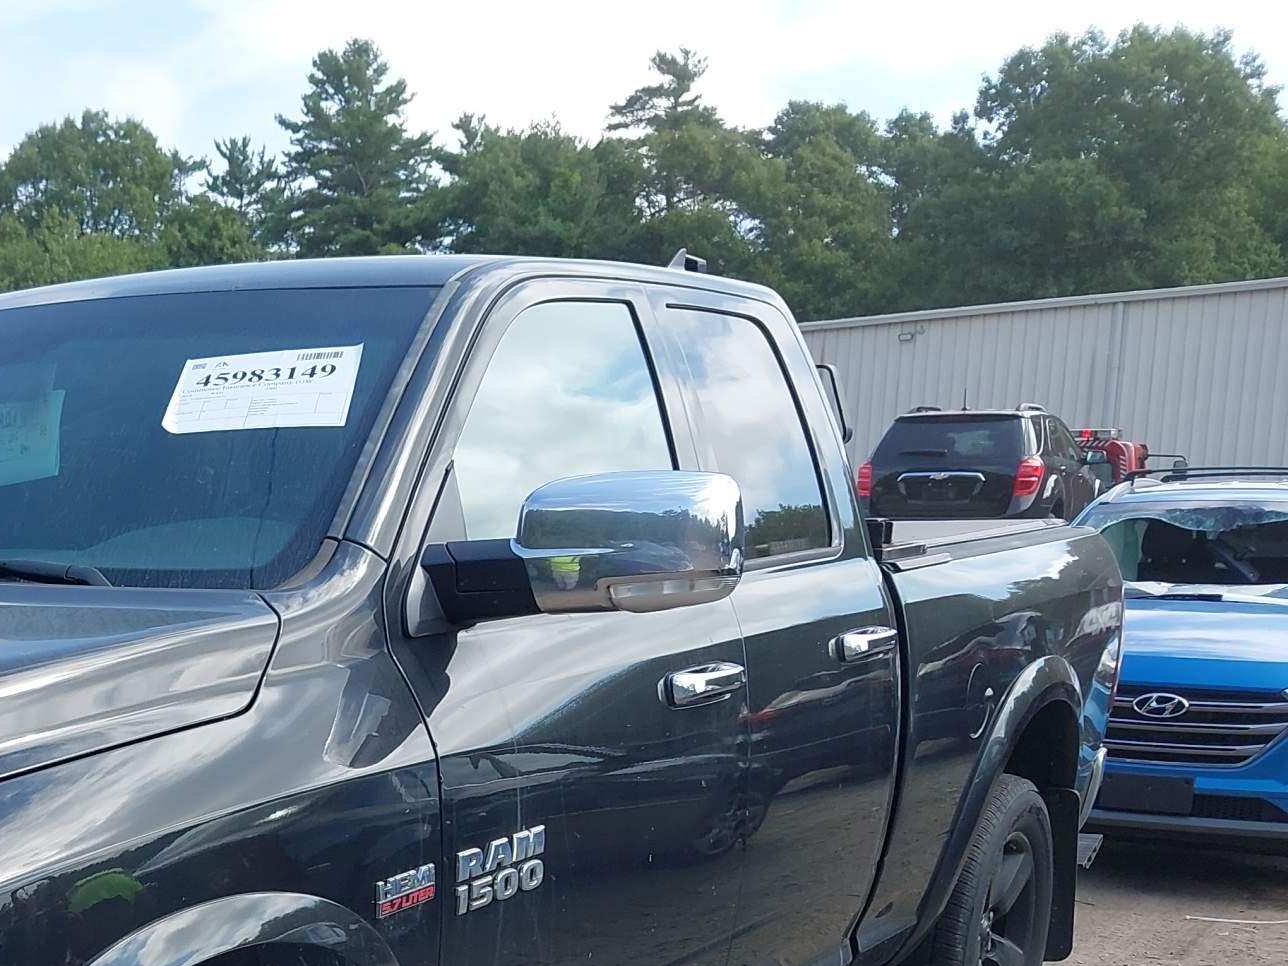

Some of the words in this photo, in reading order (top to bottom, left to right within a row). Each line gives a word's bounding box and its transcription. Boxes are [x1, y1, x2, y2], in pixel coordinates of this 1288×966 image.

[196, 362, 337, 388] 45983149
[455, 824, 546, 883] RAM
[376, 863, 436, 903] HEMI
[400, 885, 435, 910] LITER
[455, 858, 545, 916] 1500
